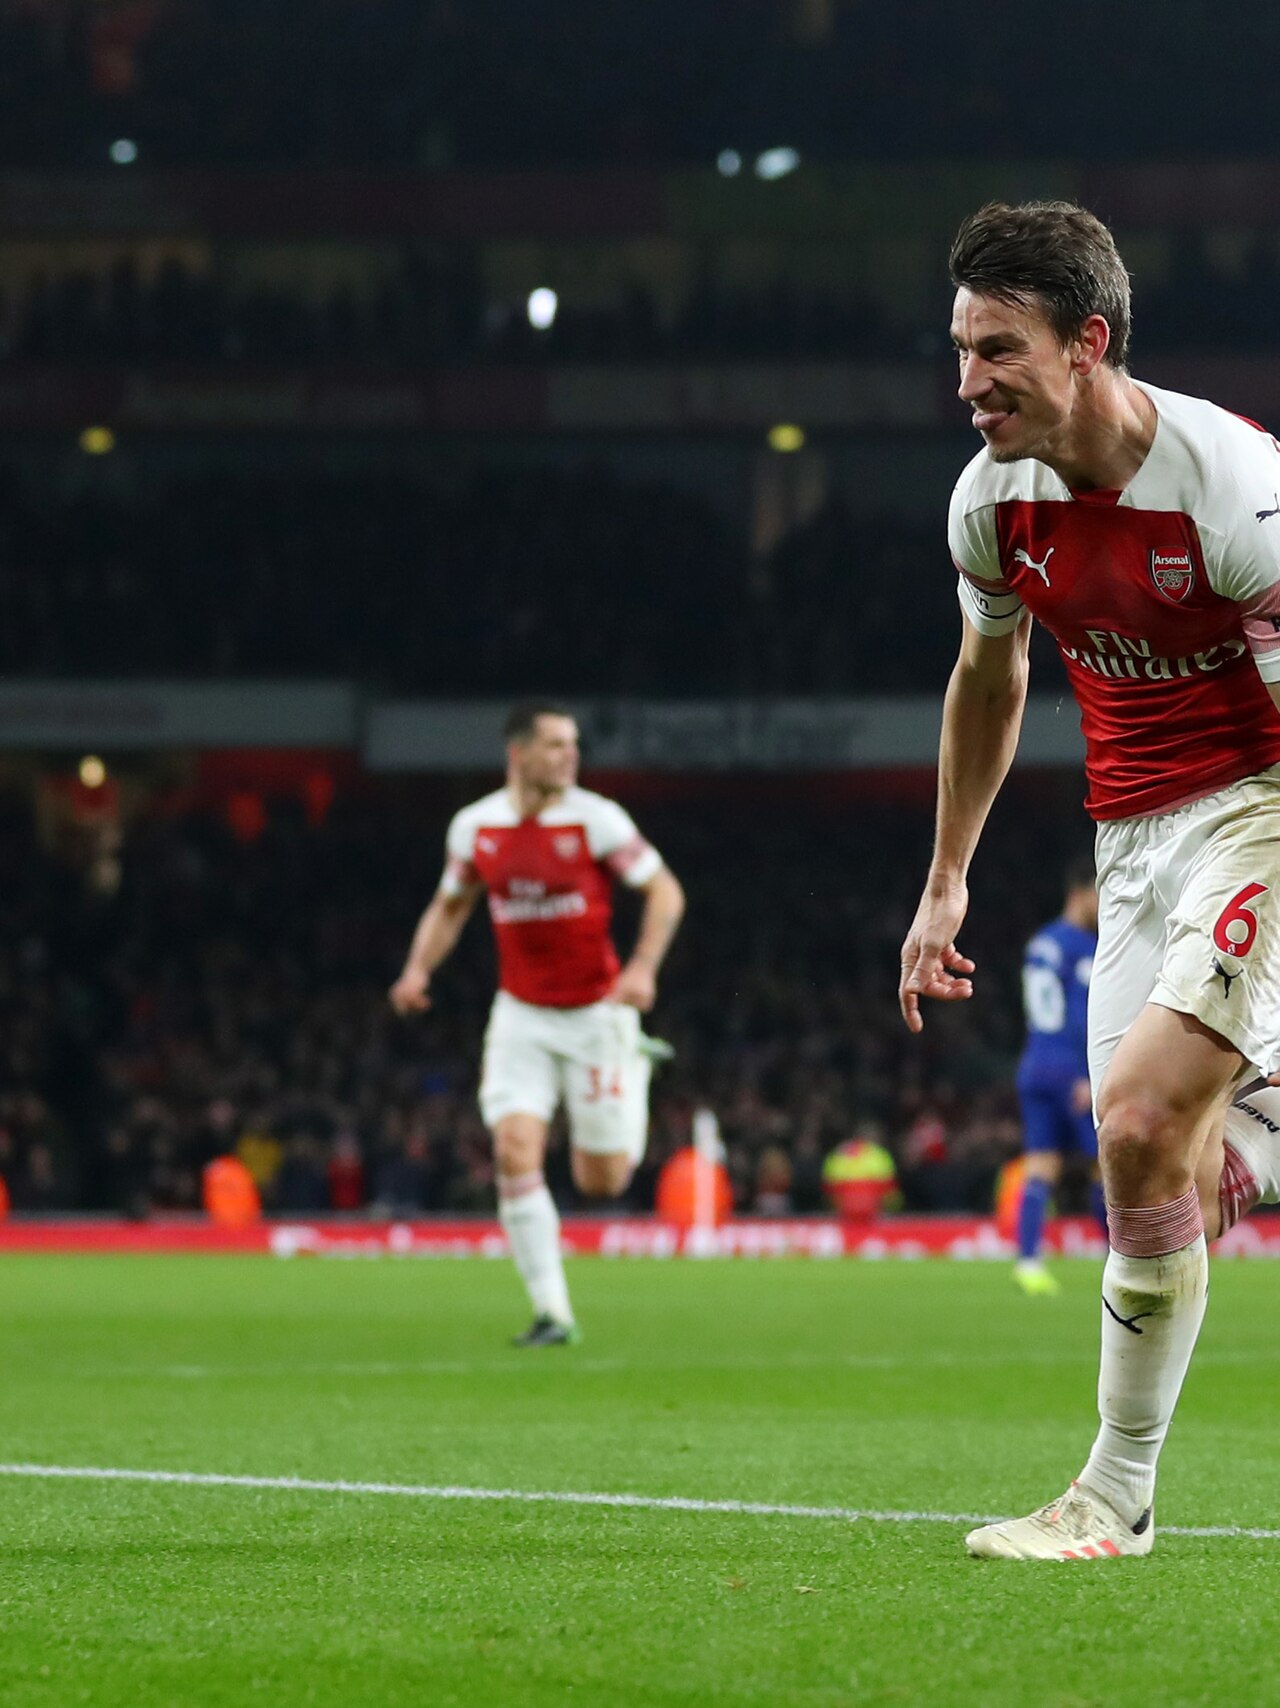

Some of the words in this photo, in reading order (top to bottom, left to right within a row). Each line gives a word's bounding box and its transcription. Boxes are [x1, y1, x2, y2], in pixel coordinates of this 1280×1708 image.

[1155, 555, 1189, 565] Arsenal
[1085, 629, 1152, 658] Fly
[1213, 881, 1270, 958] 6
